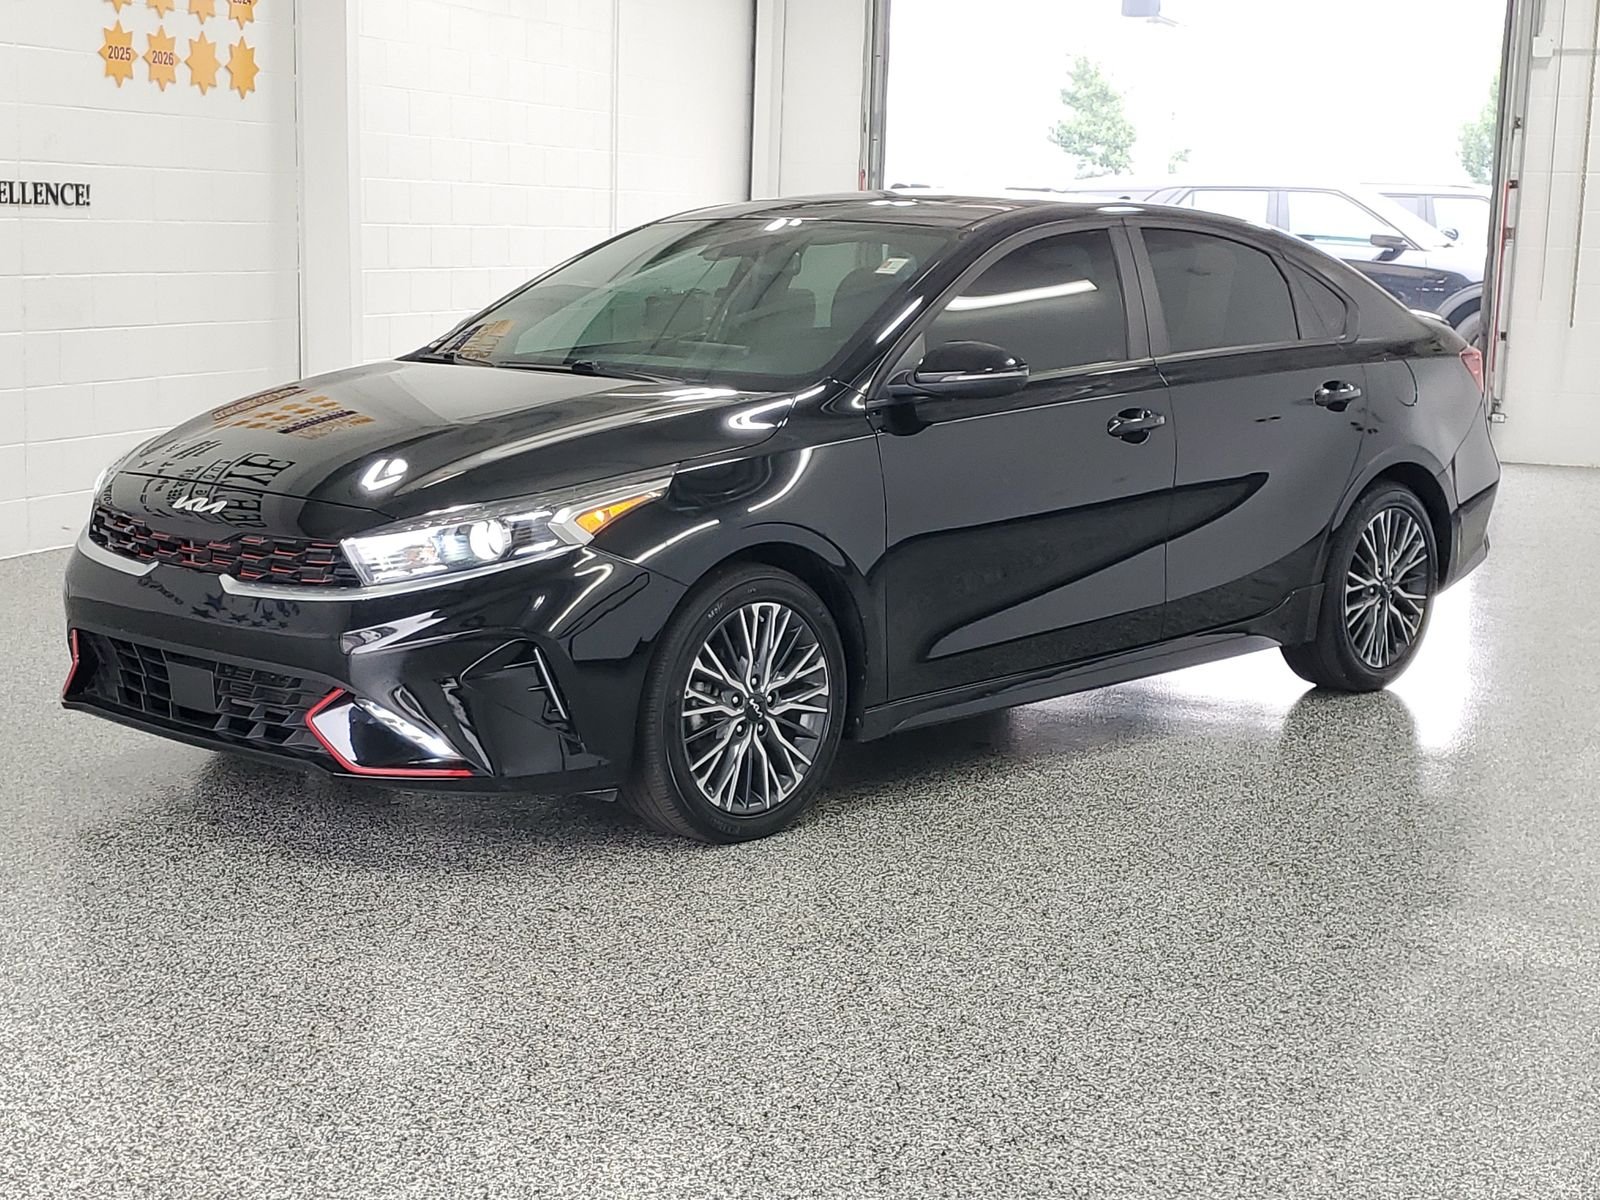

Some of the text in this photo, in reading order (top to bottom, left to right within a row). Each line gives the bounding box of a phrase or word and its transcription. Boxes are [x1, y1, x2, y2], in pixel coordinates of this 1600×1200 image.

[108, 45, 132, 62] 2025
[152, 50, 174, 66] 2026
[0, 181, 91, 206] ELLENCE!
